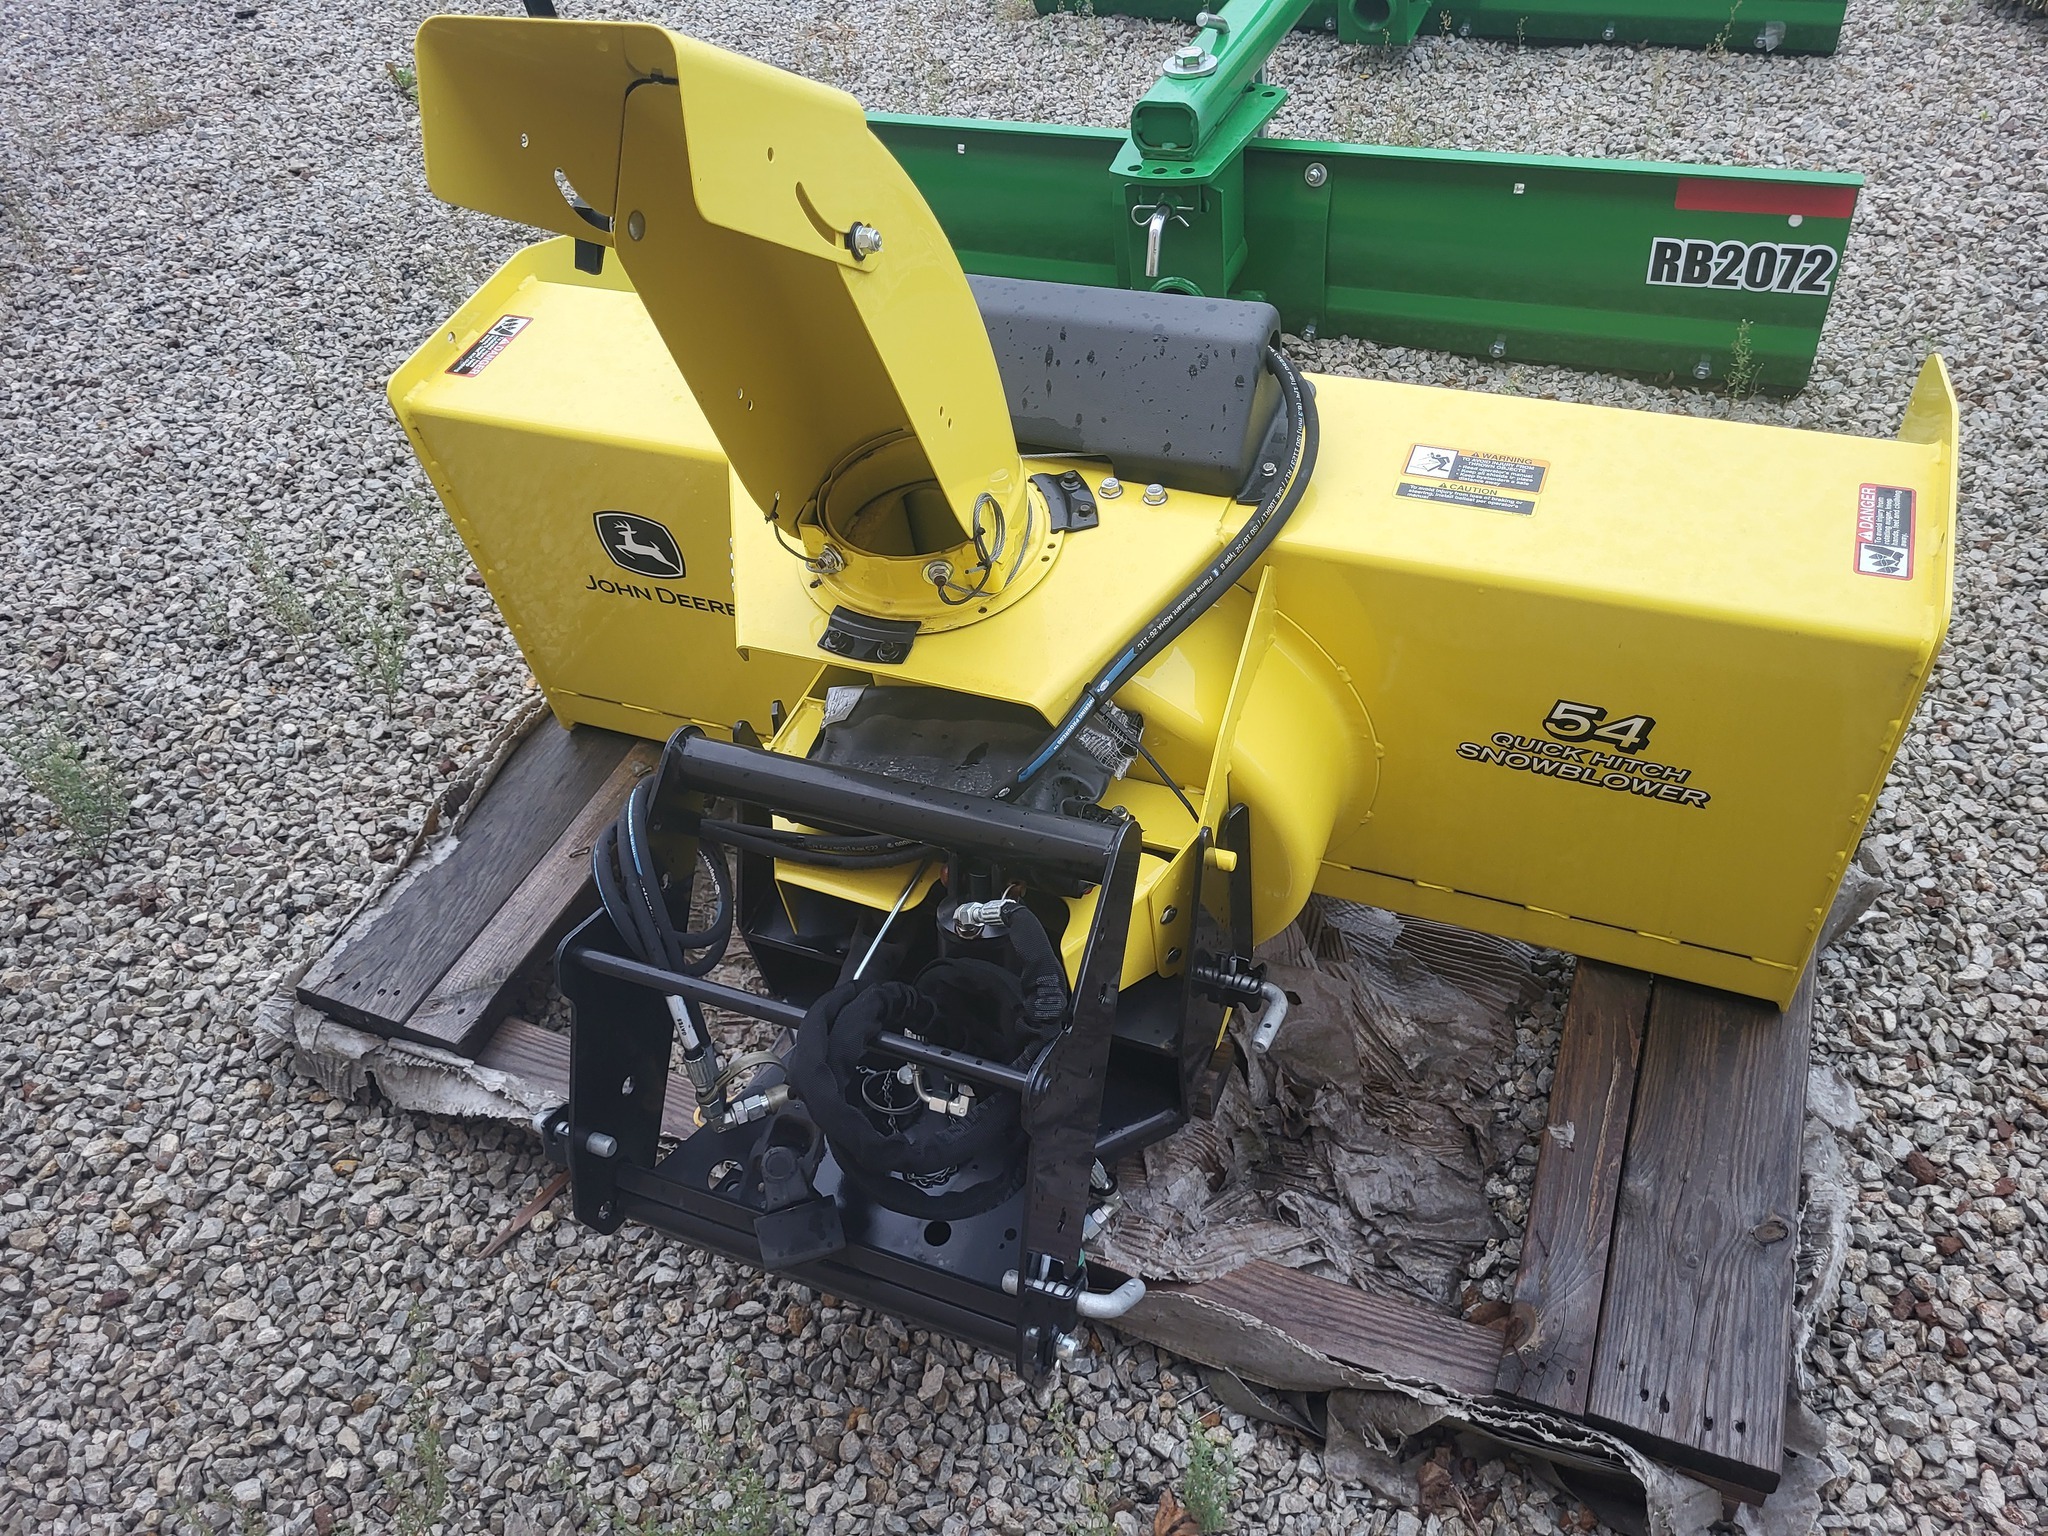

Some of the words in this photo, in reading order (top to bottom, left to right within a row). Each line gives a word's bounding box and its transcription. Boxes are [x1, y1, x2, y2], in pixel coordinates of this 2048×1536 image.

[1647, 237, 1837, 295] RB2072
[470, 345, 503, 375] DANGER
[1482, 453, 1533, 464] WARNING
[1496, 465, 1526, 473] OBJECTS
[1275, 486, 1284, 499] SAE
[1450, 484, 1498, 495] CAUTION
[1262, 498, 1278, 520] 100R17
[1859, 487, 1876, 529] DANGER
[1894, 490, 1903, 509] clothing
[1877, 509, 1885, 523] injury
[1892, 519, 1900, 529] feet
[1251, 524, 1260, 537] ISO
[1235, 534, 1251, 554] 18752
[1224, 551, 1237, 566] Type
[1196, 575, 1214, 593] Flame
[585, 575, 652, 601] JOHN
[655, 586, 736, 617] DEERE
[1172, 590, 1198, 616] Resistant
[1158, 613, 1174, 631] MSHA
[1137, 628, 1159, 650] 2G-11C
[1542, 699, 1656, 755] 54
[1491, 732, 1593, 764] QUICK
[1591, 751, 1691, 783] HITCH
[1456, 742, 1711, 809] SNOWBLOWER
[676, 1018, 687, 1036] GATES
